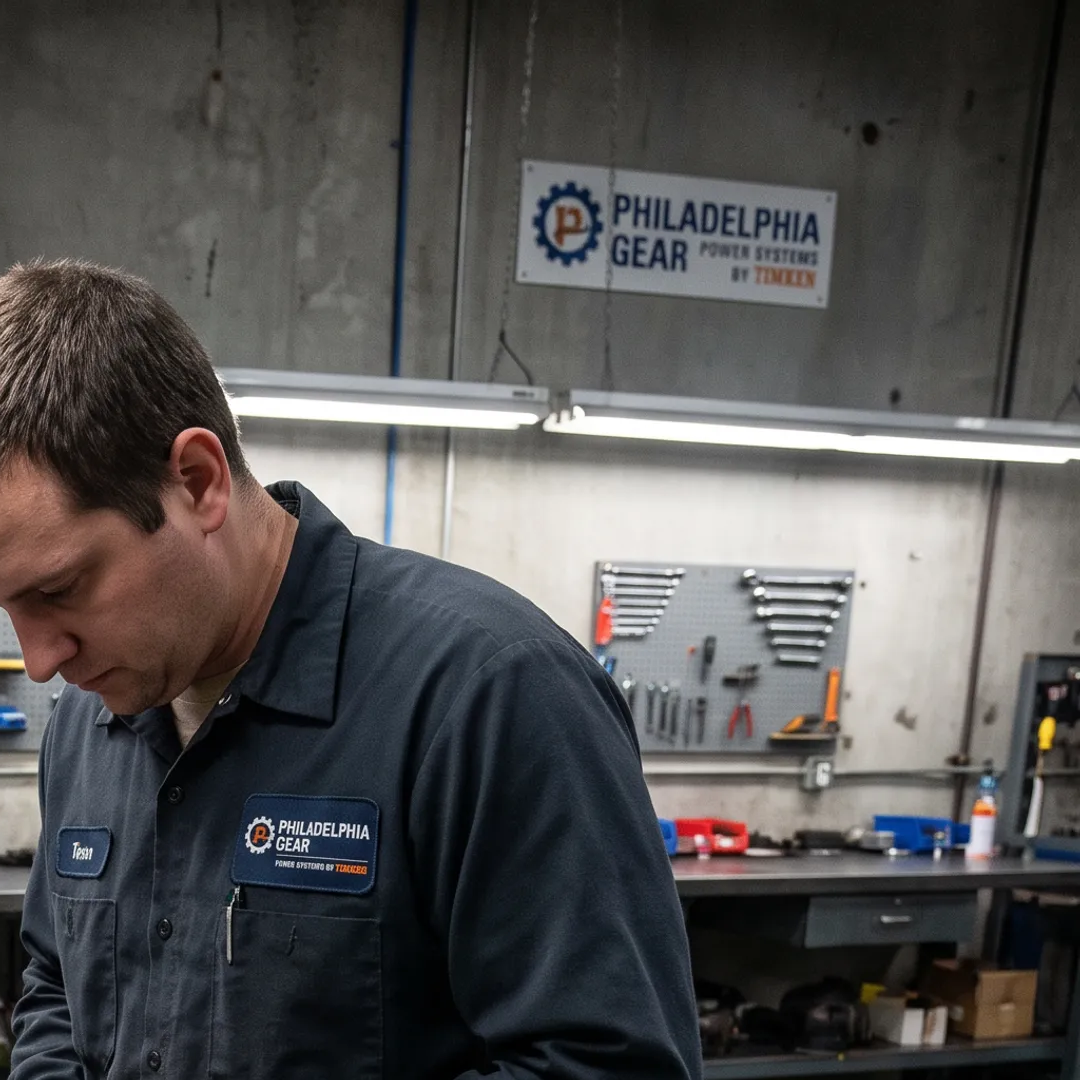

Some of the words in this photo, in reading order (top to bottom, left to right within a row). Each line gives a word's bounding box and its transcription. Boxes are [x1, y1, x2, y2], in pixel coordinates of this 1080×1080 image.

[612, 194, 820, 245] PHILADELPHIA
[611, 233, 688, 272] GEAR
[731, 266, 749, 283] BY
[278, 819, 370, 840] PHILADELPHIA
[275, 836, 310, 853] GEAR
